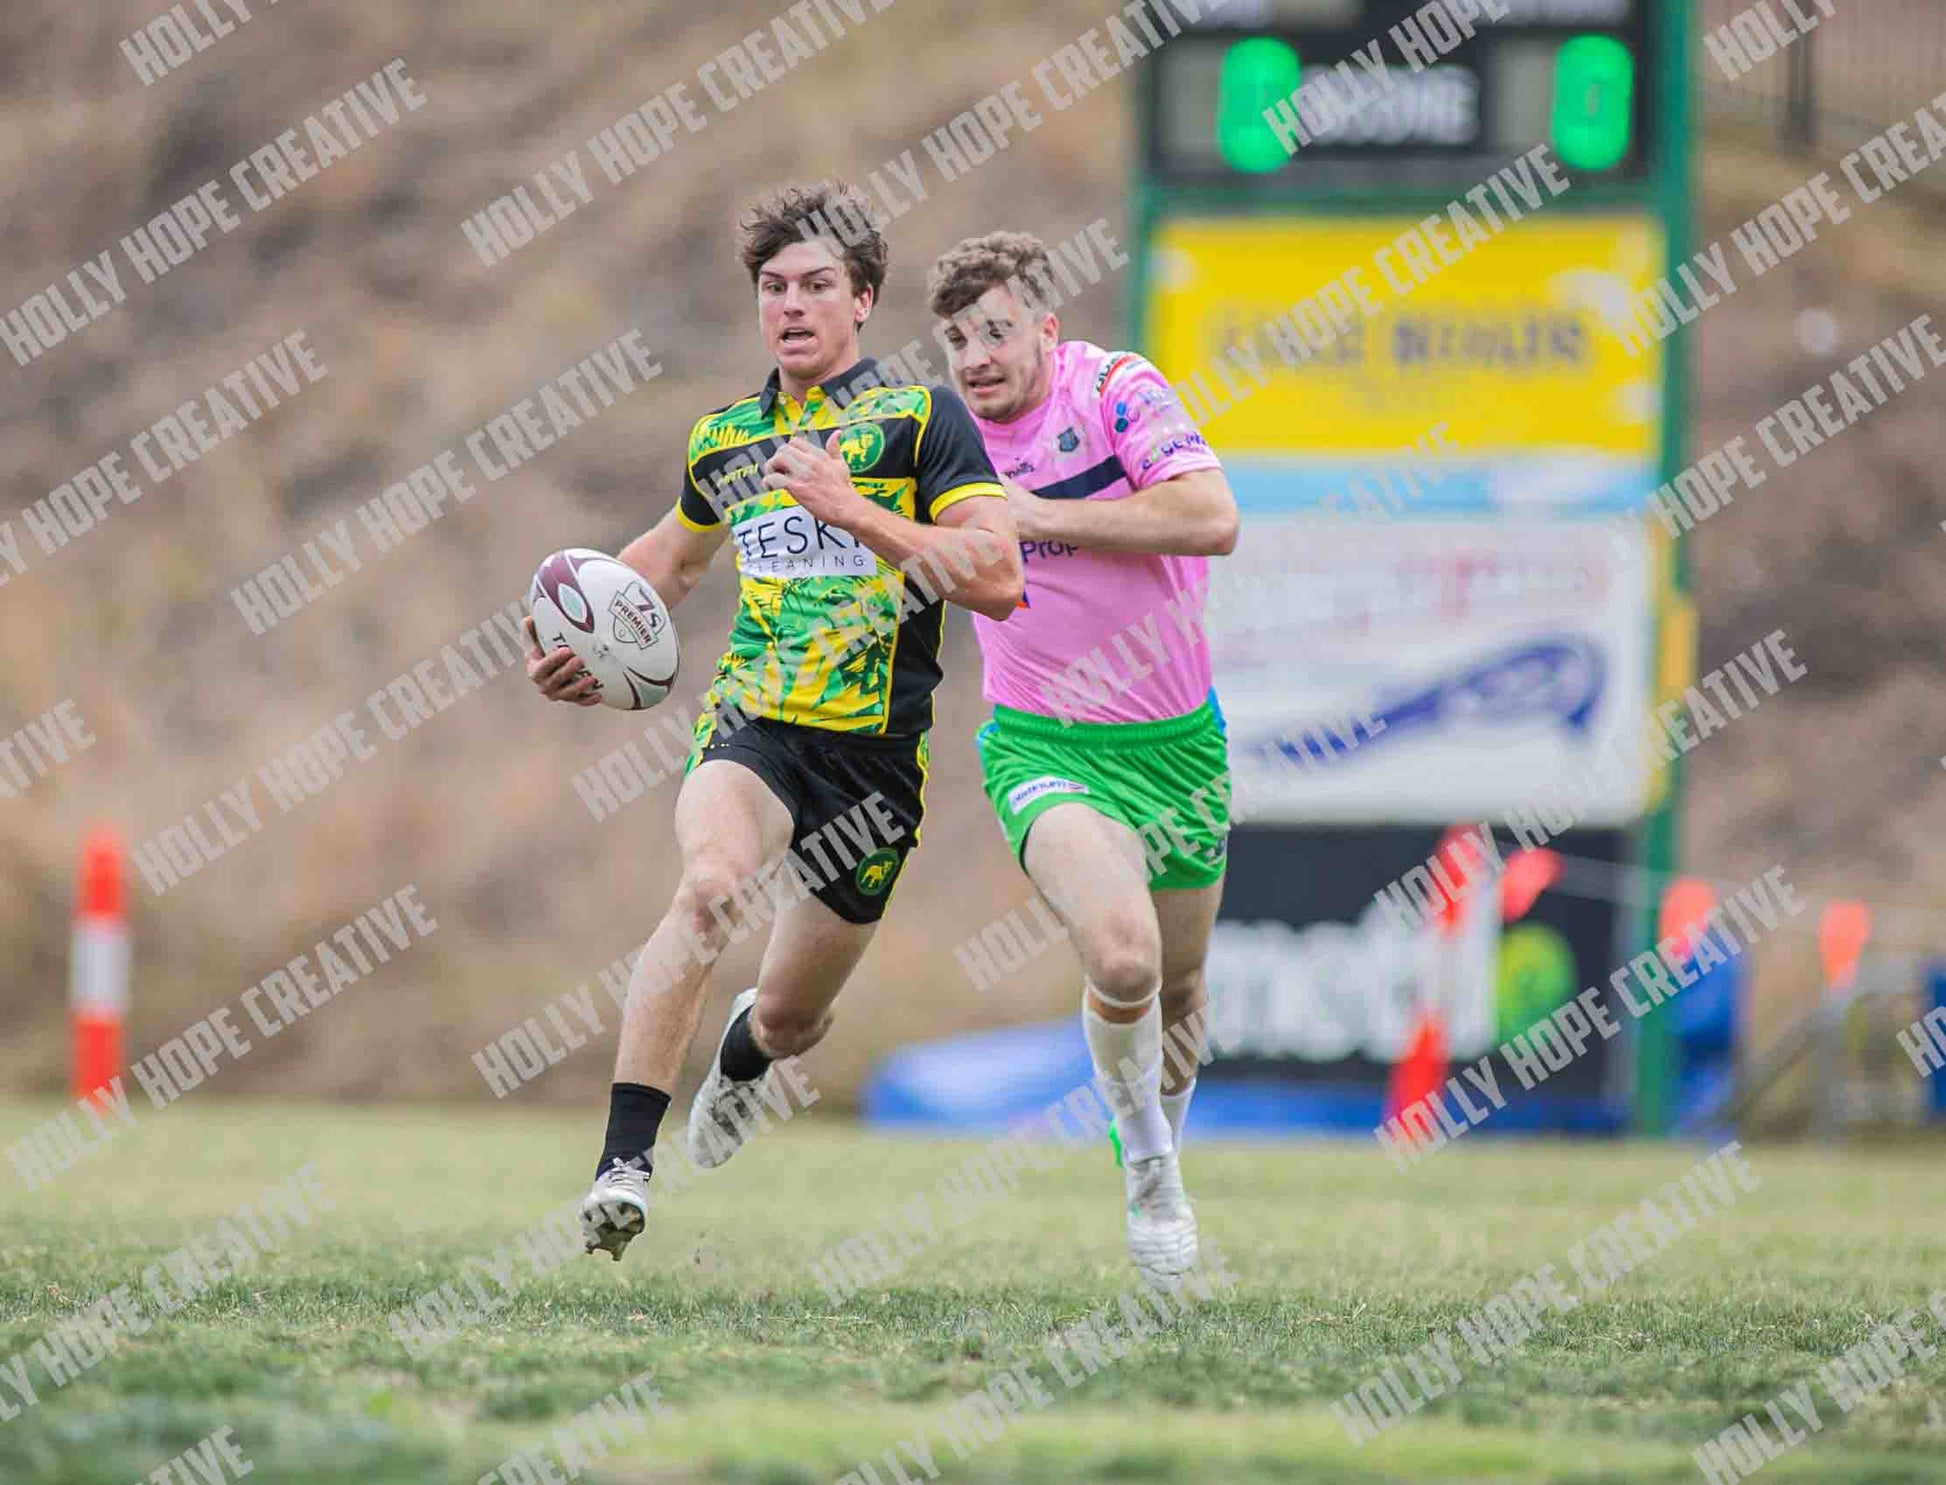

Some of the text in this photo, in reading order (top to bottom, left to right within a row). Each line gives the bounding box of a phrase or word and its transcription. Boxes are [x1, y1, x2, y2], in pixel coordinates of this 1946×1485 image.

[738, 516, 860, 560] TESK
[748, 553, 865, 573] LEANING
[614, 600, 652, 644] PREMIER
